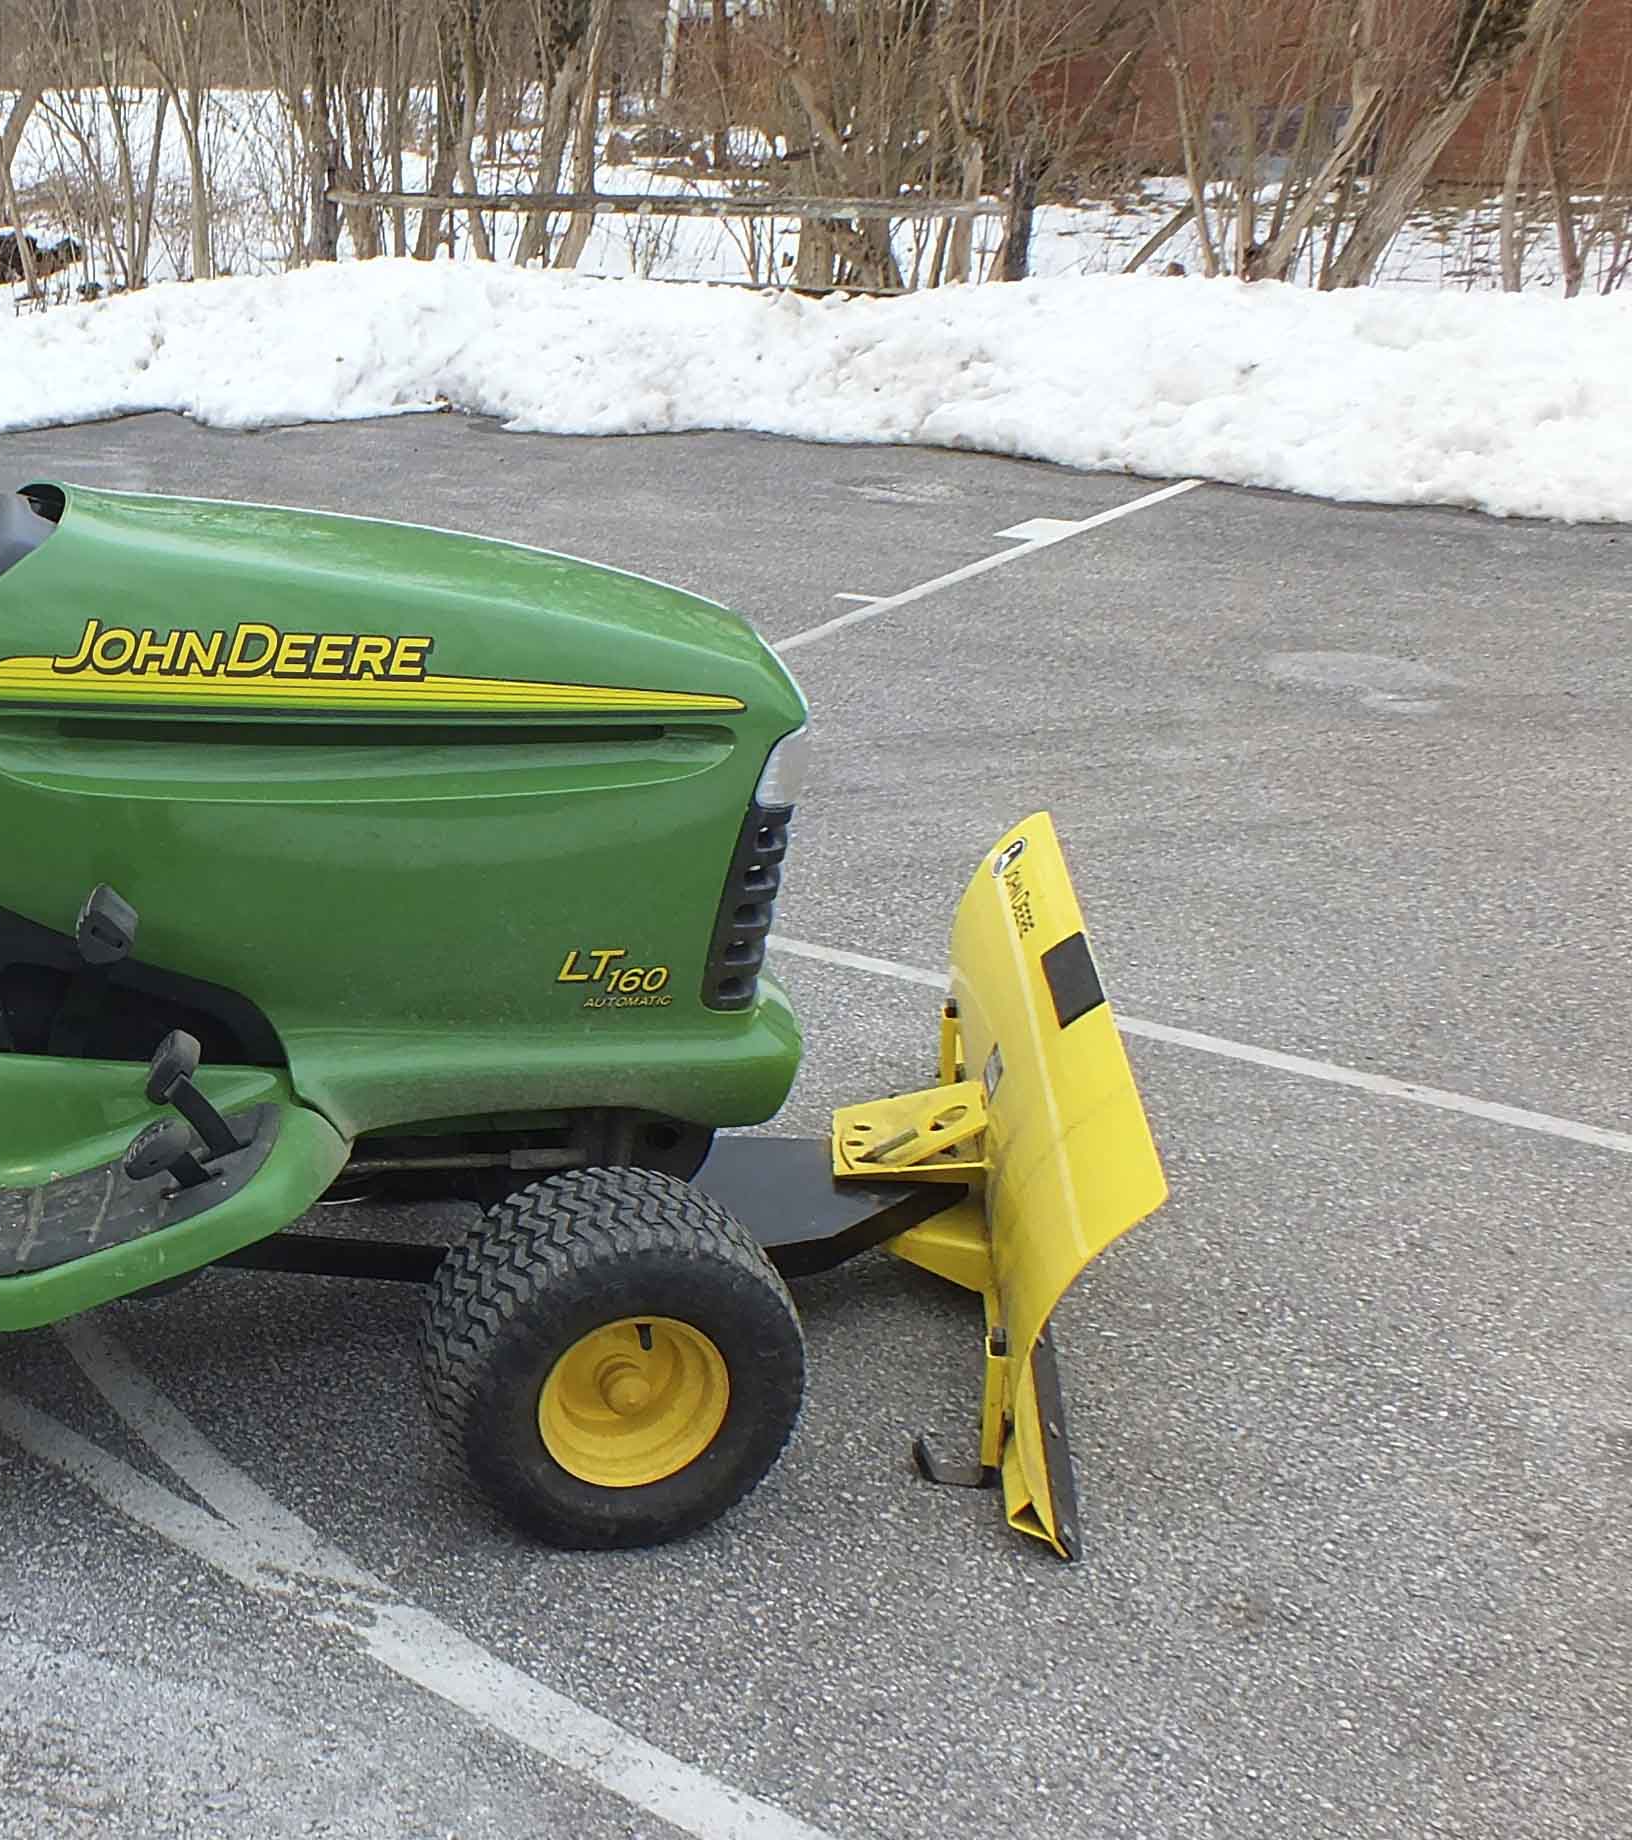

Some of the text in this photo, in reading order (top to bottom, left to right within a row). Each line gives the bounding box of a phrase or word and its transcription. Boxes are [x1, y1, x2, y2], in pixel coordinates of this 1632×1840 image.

[52, 619, 432, 680] JOHN DEERE
[583, 995, 672, 1008] AUTOMATIC
